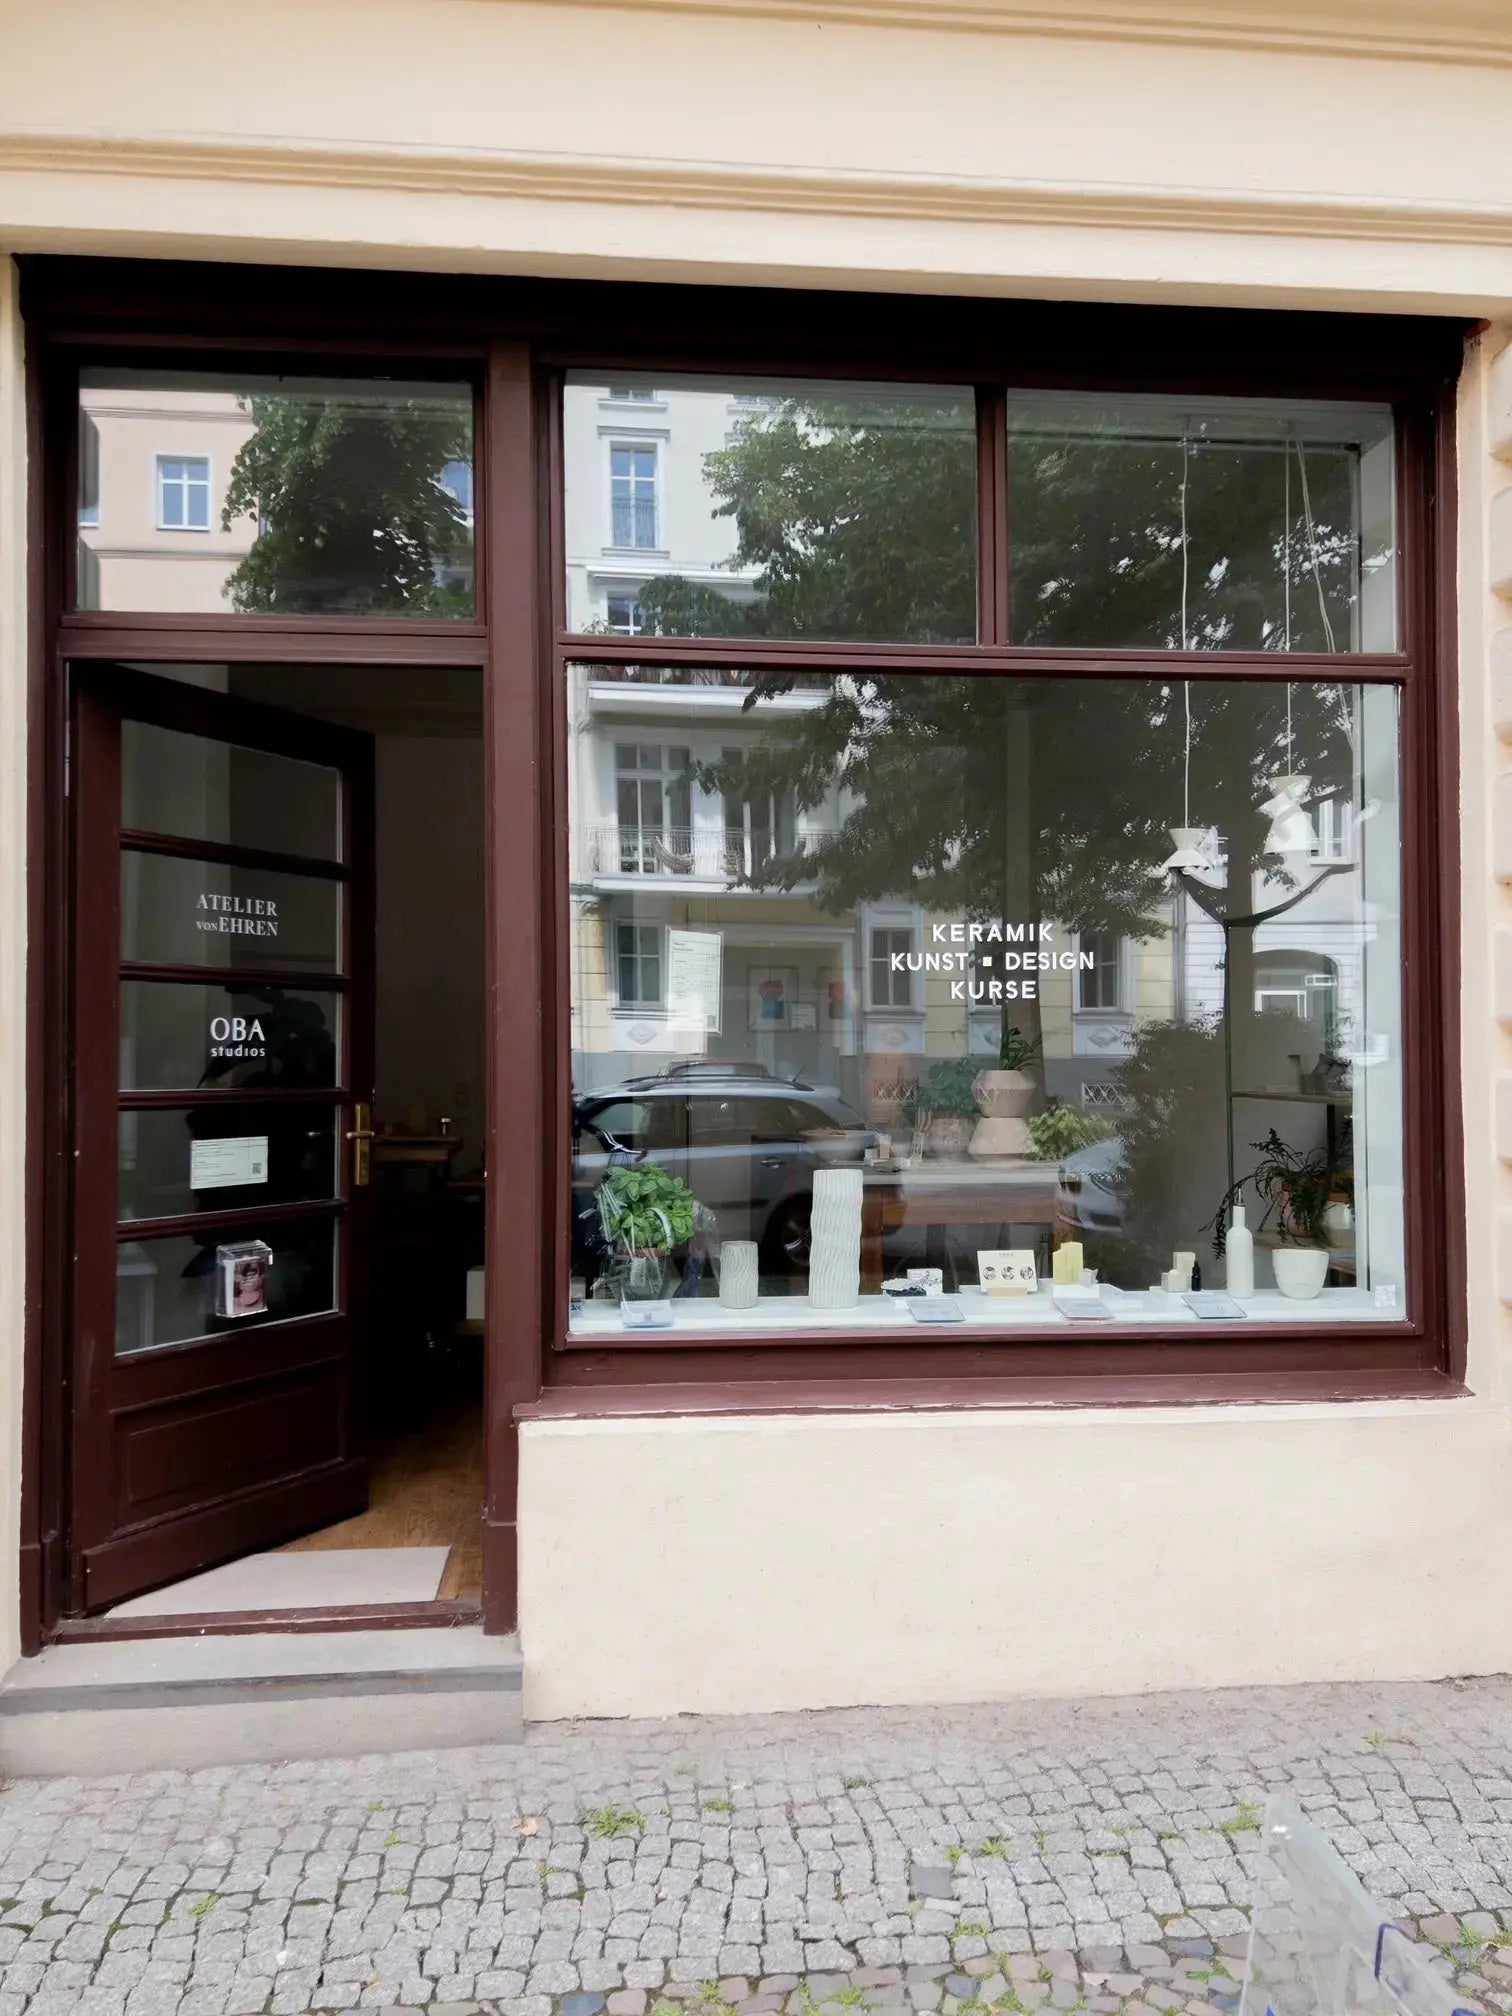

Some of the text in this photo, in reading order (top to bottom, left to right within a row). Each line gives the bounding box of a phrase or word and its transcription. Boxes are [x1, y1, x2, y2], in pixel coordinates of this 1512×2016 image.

[196, 894, 278, 916] ATELIER
[932, 923, 1054, 943] KERAMIK
[891, 951, 1095, 972] KUNST DESIGN
[951, 980, 1037, 1000] KURSE
[209, 1017, 266, 1041] OBA
